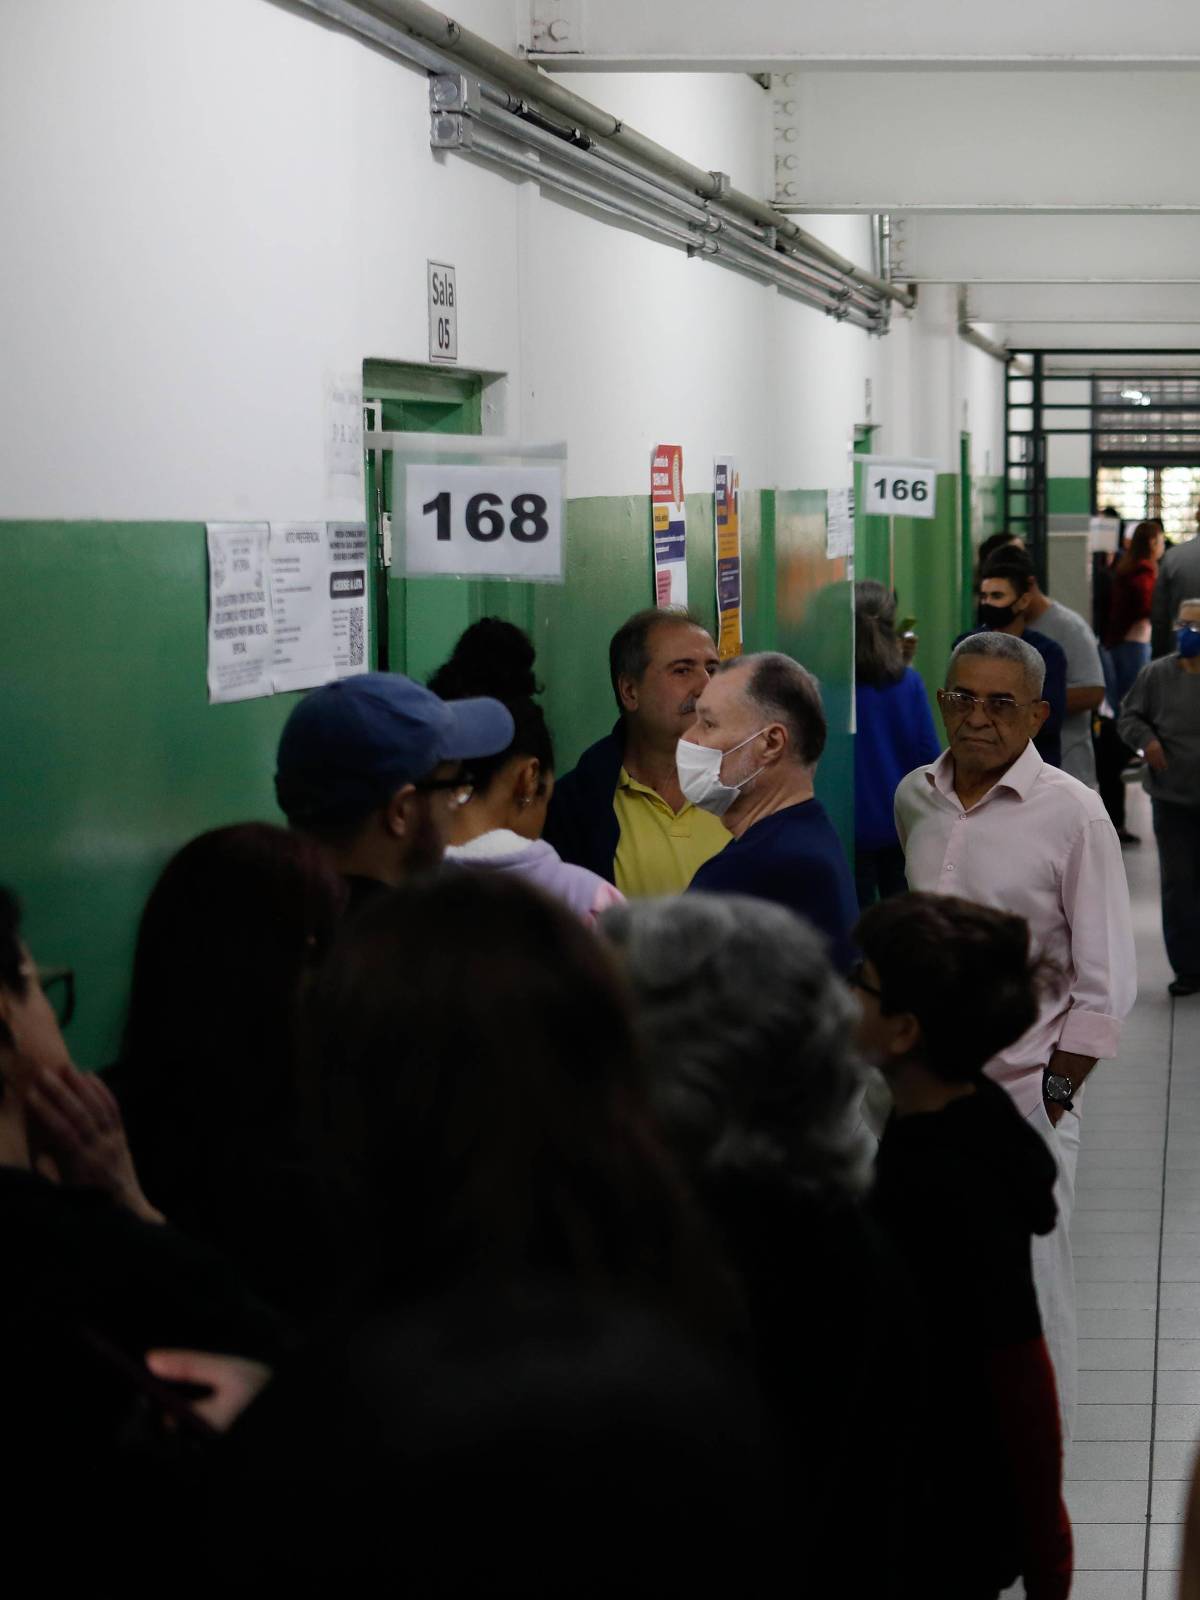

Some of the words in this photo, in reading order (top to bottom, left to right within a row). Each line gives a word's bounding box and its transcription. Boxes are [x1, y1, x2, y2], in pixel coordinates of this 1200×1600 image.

[431, 272, 455, 307] Sala
[438, 317, 451, 349] 05
[873, 477, 929, 502] 166
[422, 491, 550, 542] 168
